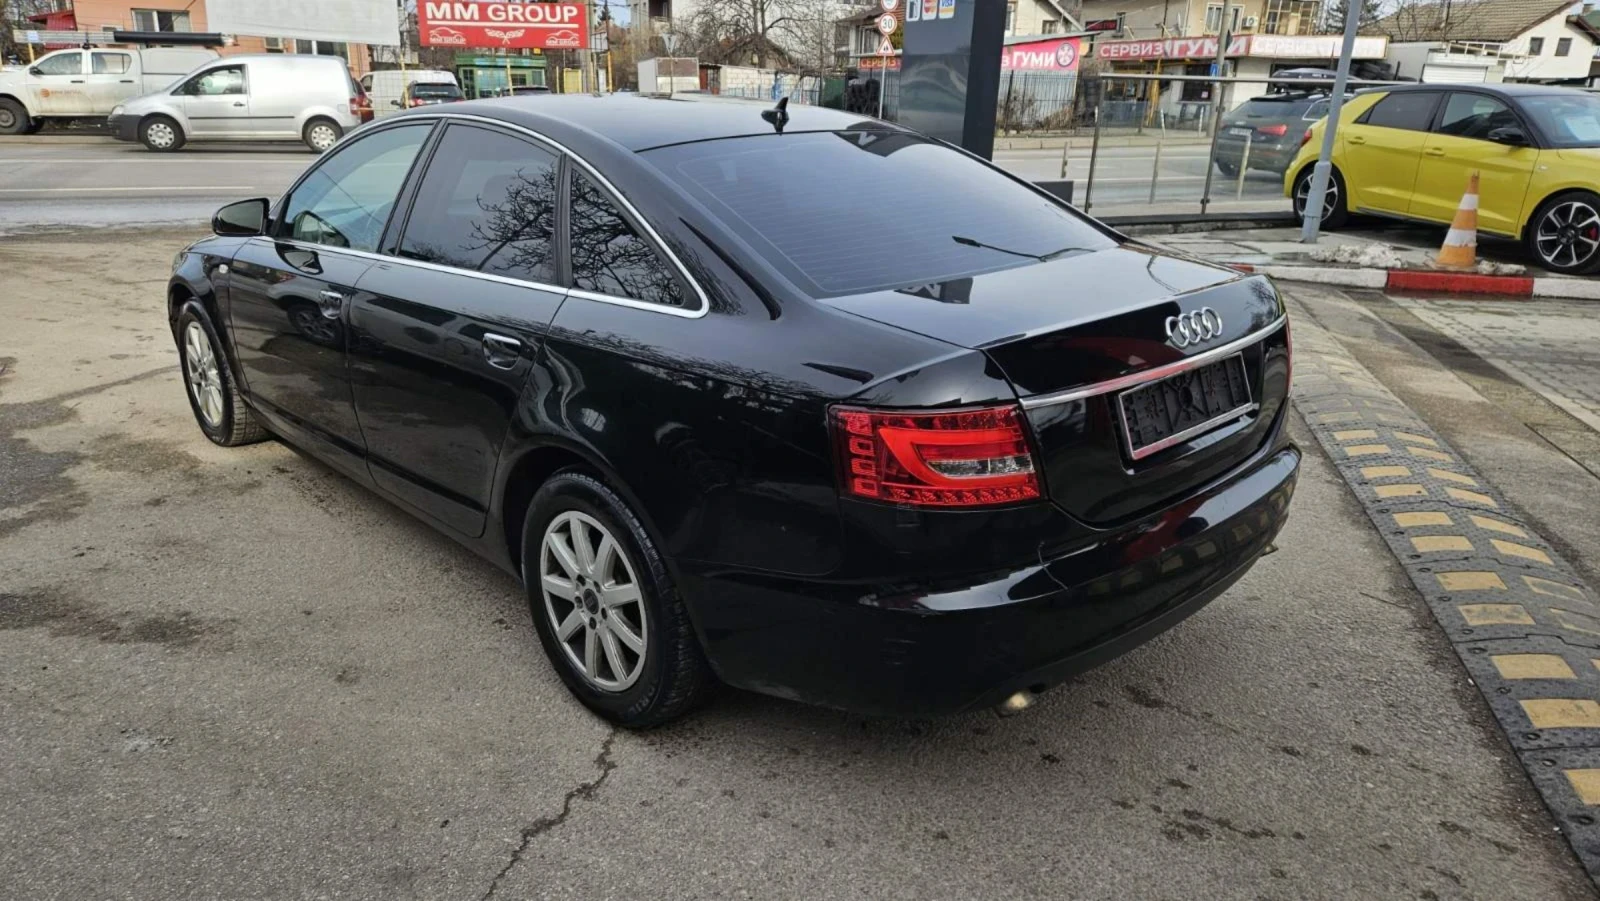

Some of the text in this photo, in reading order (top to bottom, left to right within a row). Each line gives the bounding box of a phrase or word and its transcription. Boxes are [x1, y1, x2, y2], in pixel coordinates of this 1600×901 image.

[426, 2, 578, 23] MM GROUP
[882, 19, 893, 29] 30
[1100, 38, 1247, 57] СЕРВИЗ ГУМИ
[1013, 51, 1056, 67] ГУМИ
